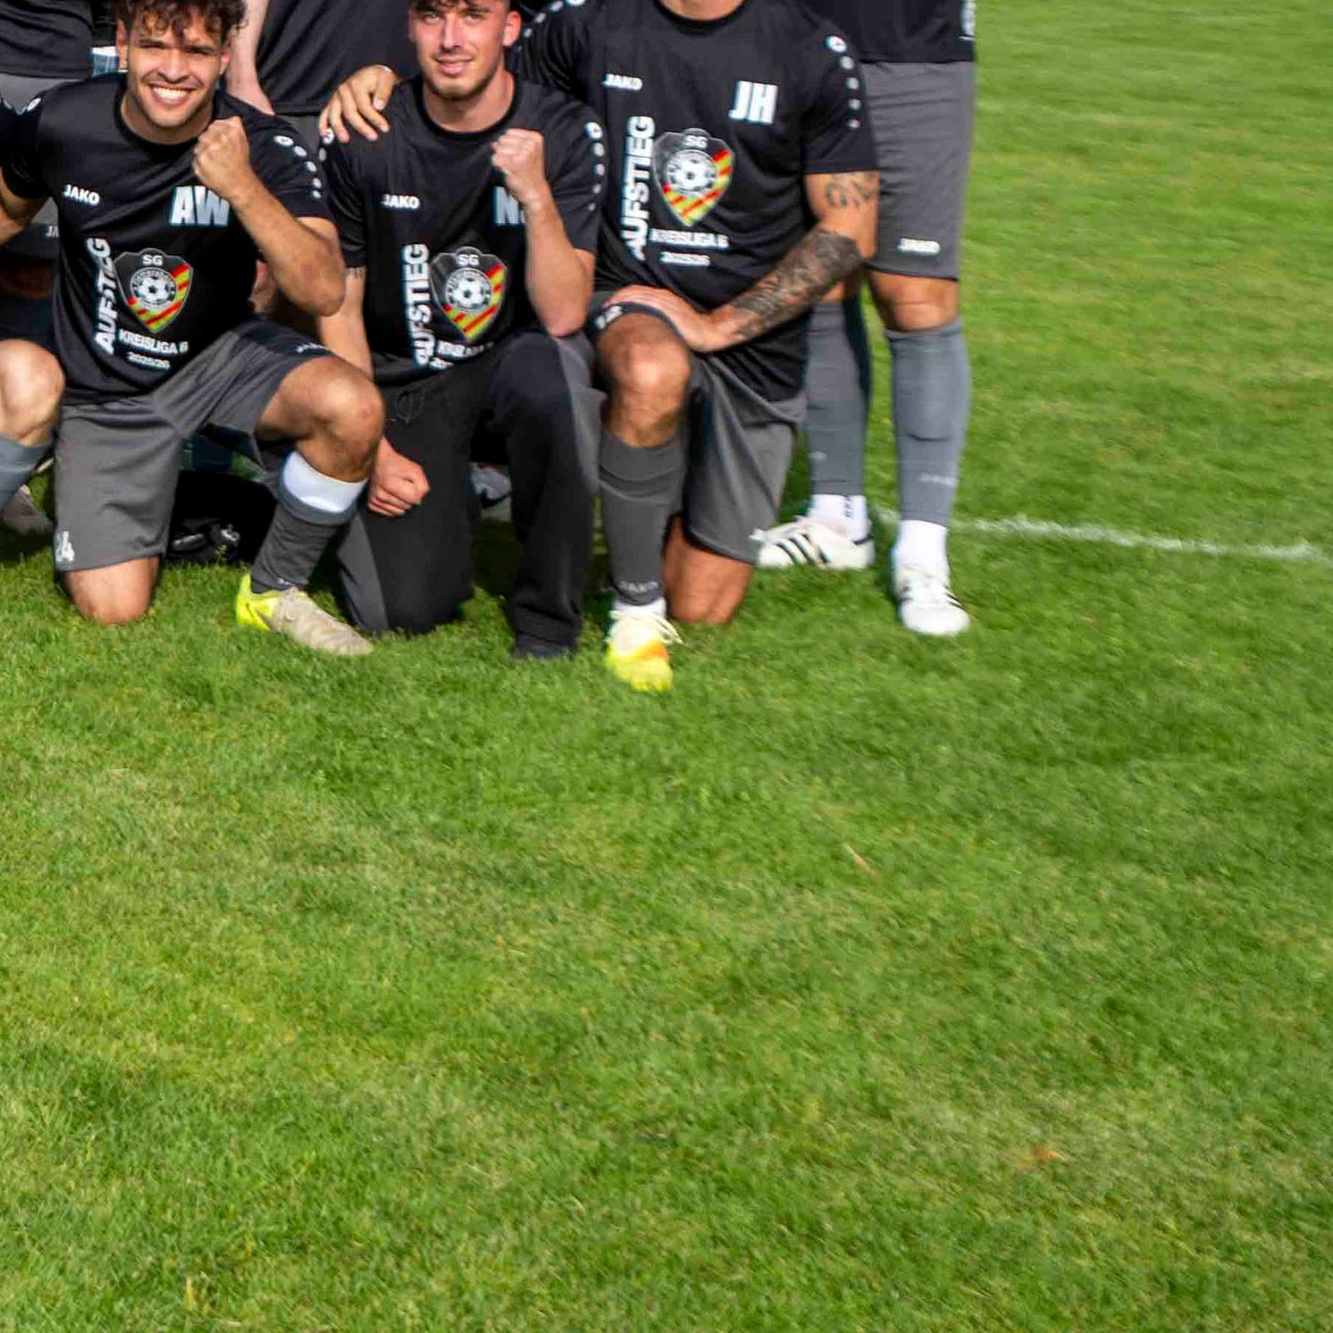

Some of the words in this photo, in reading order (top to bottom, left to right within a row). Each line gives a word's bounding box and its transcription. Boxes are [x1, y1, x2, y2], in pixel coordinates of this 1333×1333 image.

[729, 81, 778, 124] JH
[63, 184, 100, 206] JAKO
[170, 186, 230, 226] AW
[142, 255, 163, 266] SG
[458, 254, 479, 266] SG
